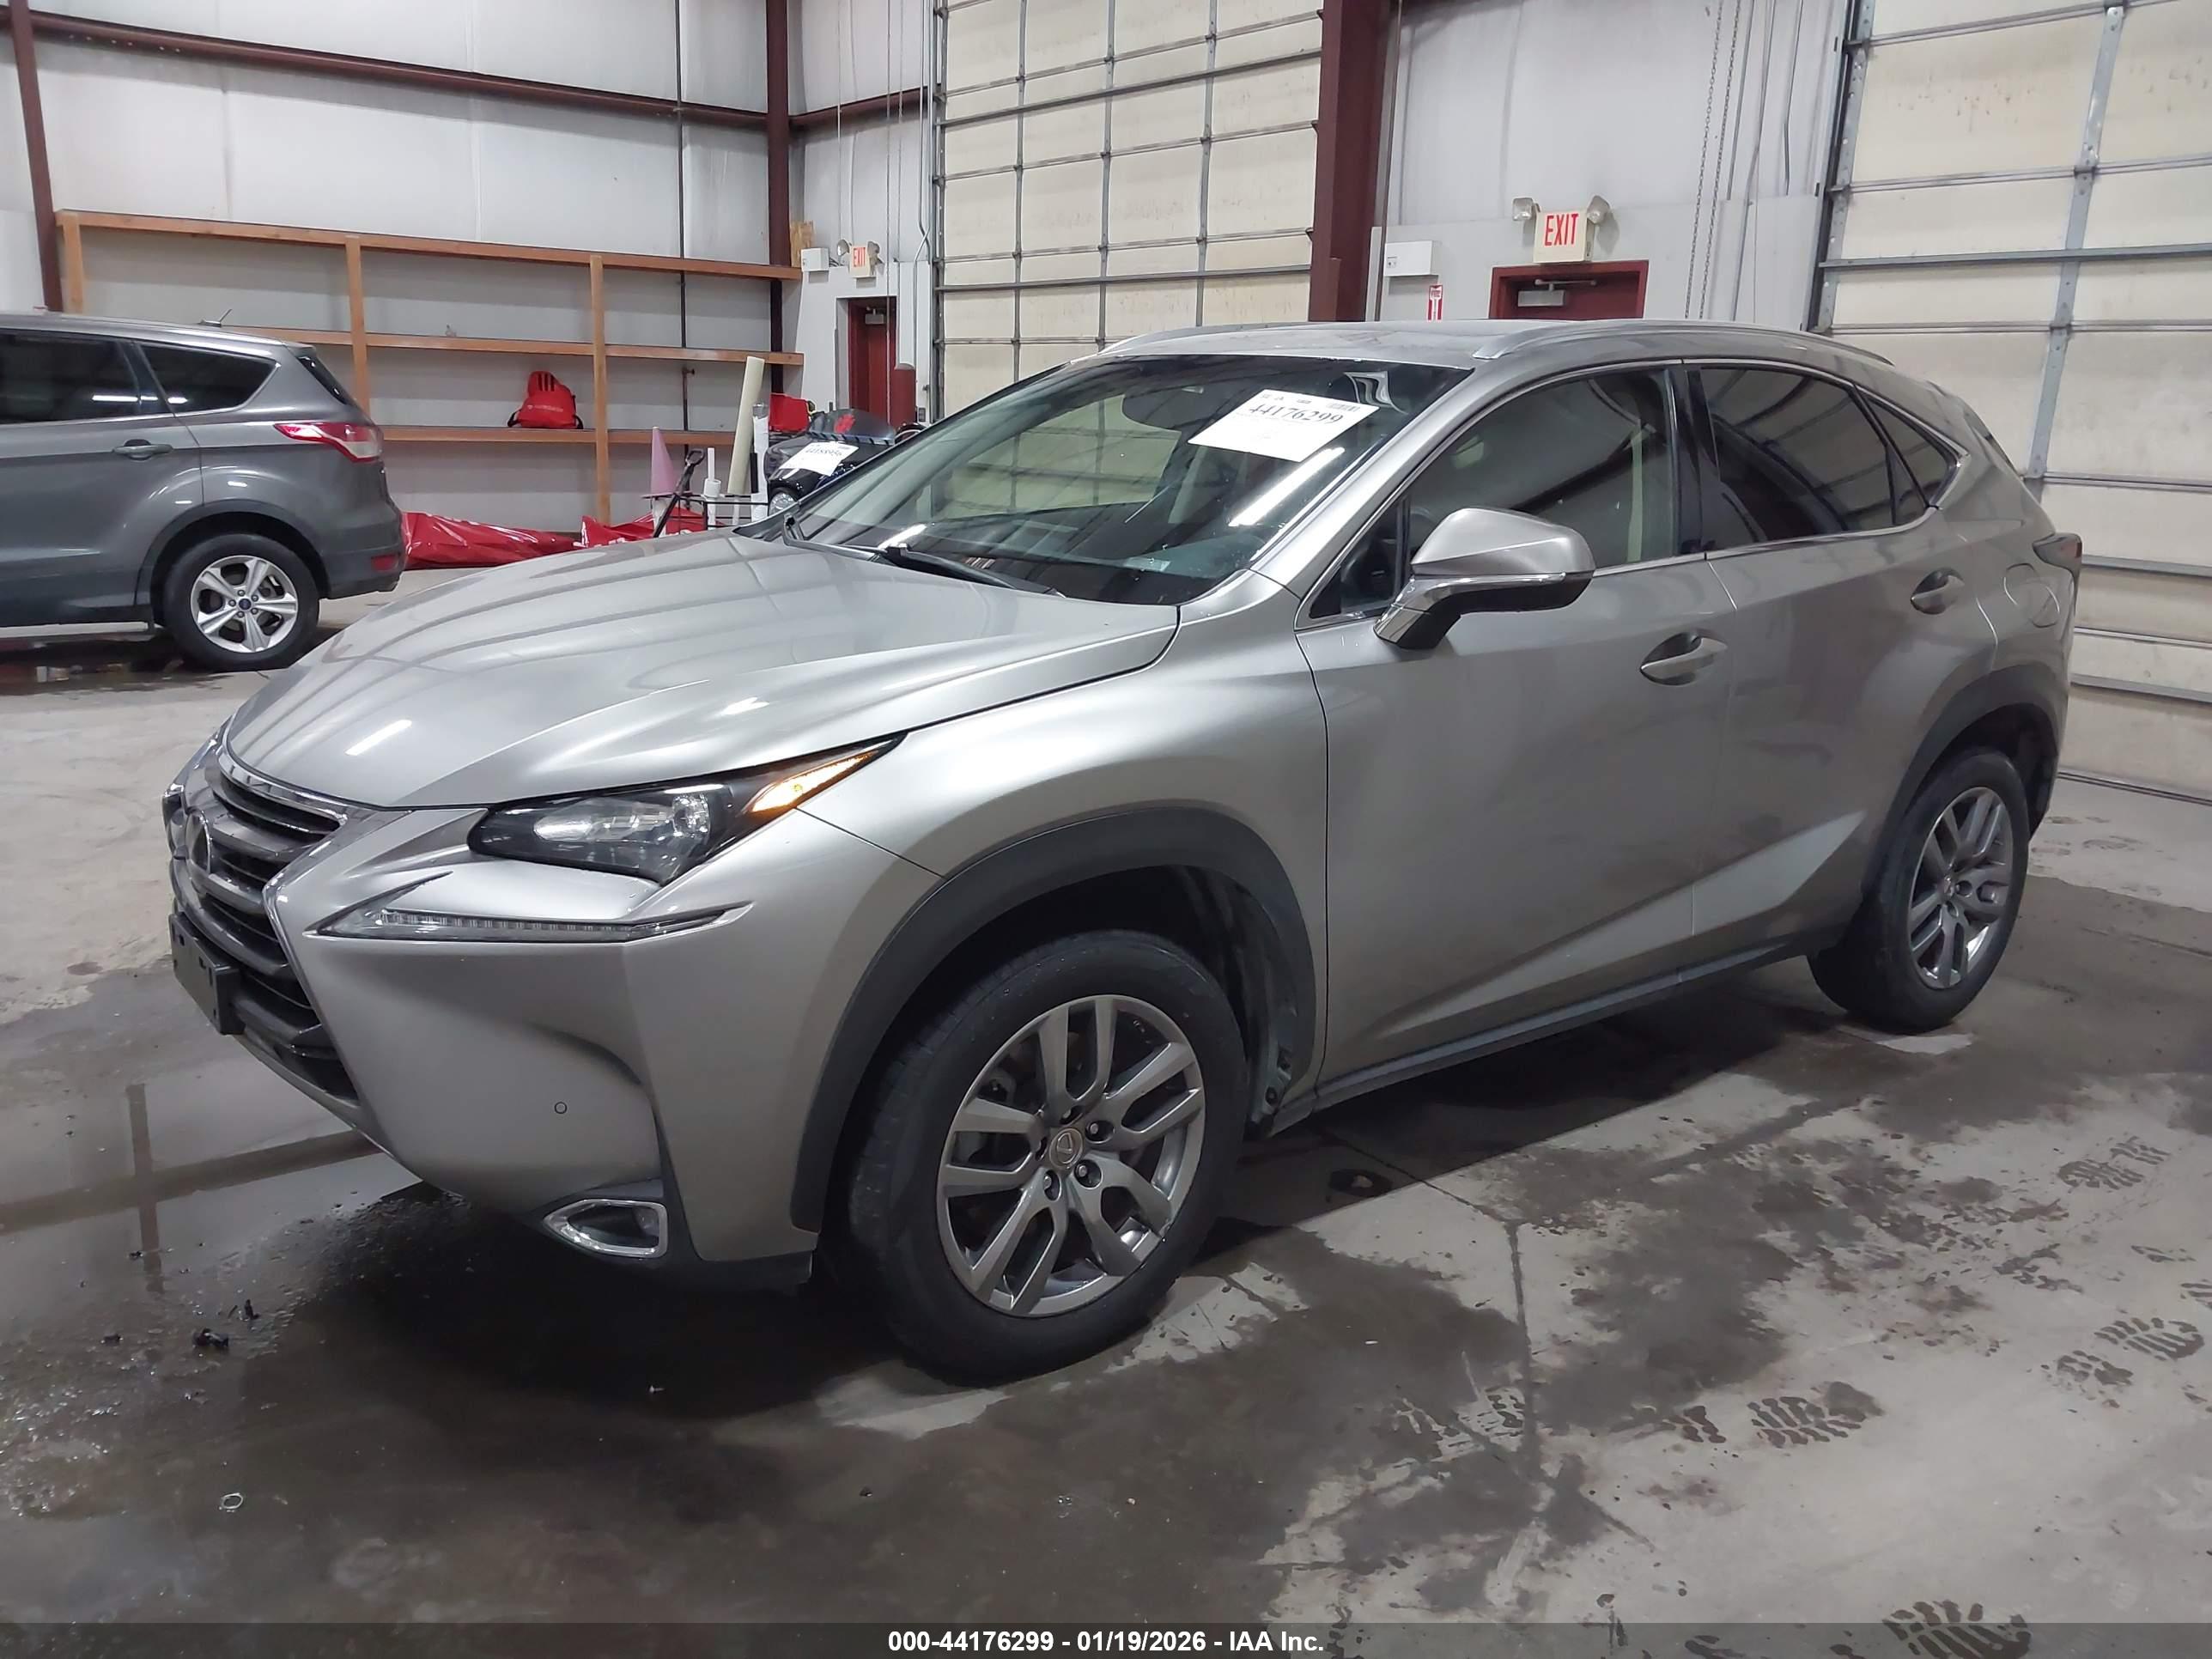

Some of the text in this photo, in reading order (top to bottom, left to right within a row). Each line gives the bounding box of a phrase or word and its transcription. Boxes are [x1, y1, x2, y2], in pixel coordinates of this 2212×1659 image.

[1544, 213, 1578, 246] EXIT
[853, 246, 866, 268] EXIT
[1249, 403, 1344, 424] 44176299
